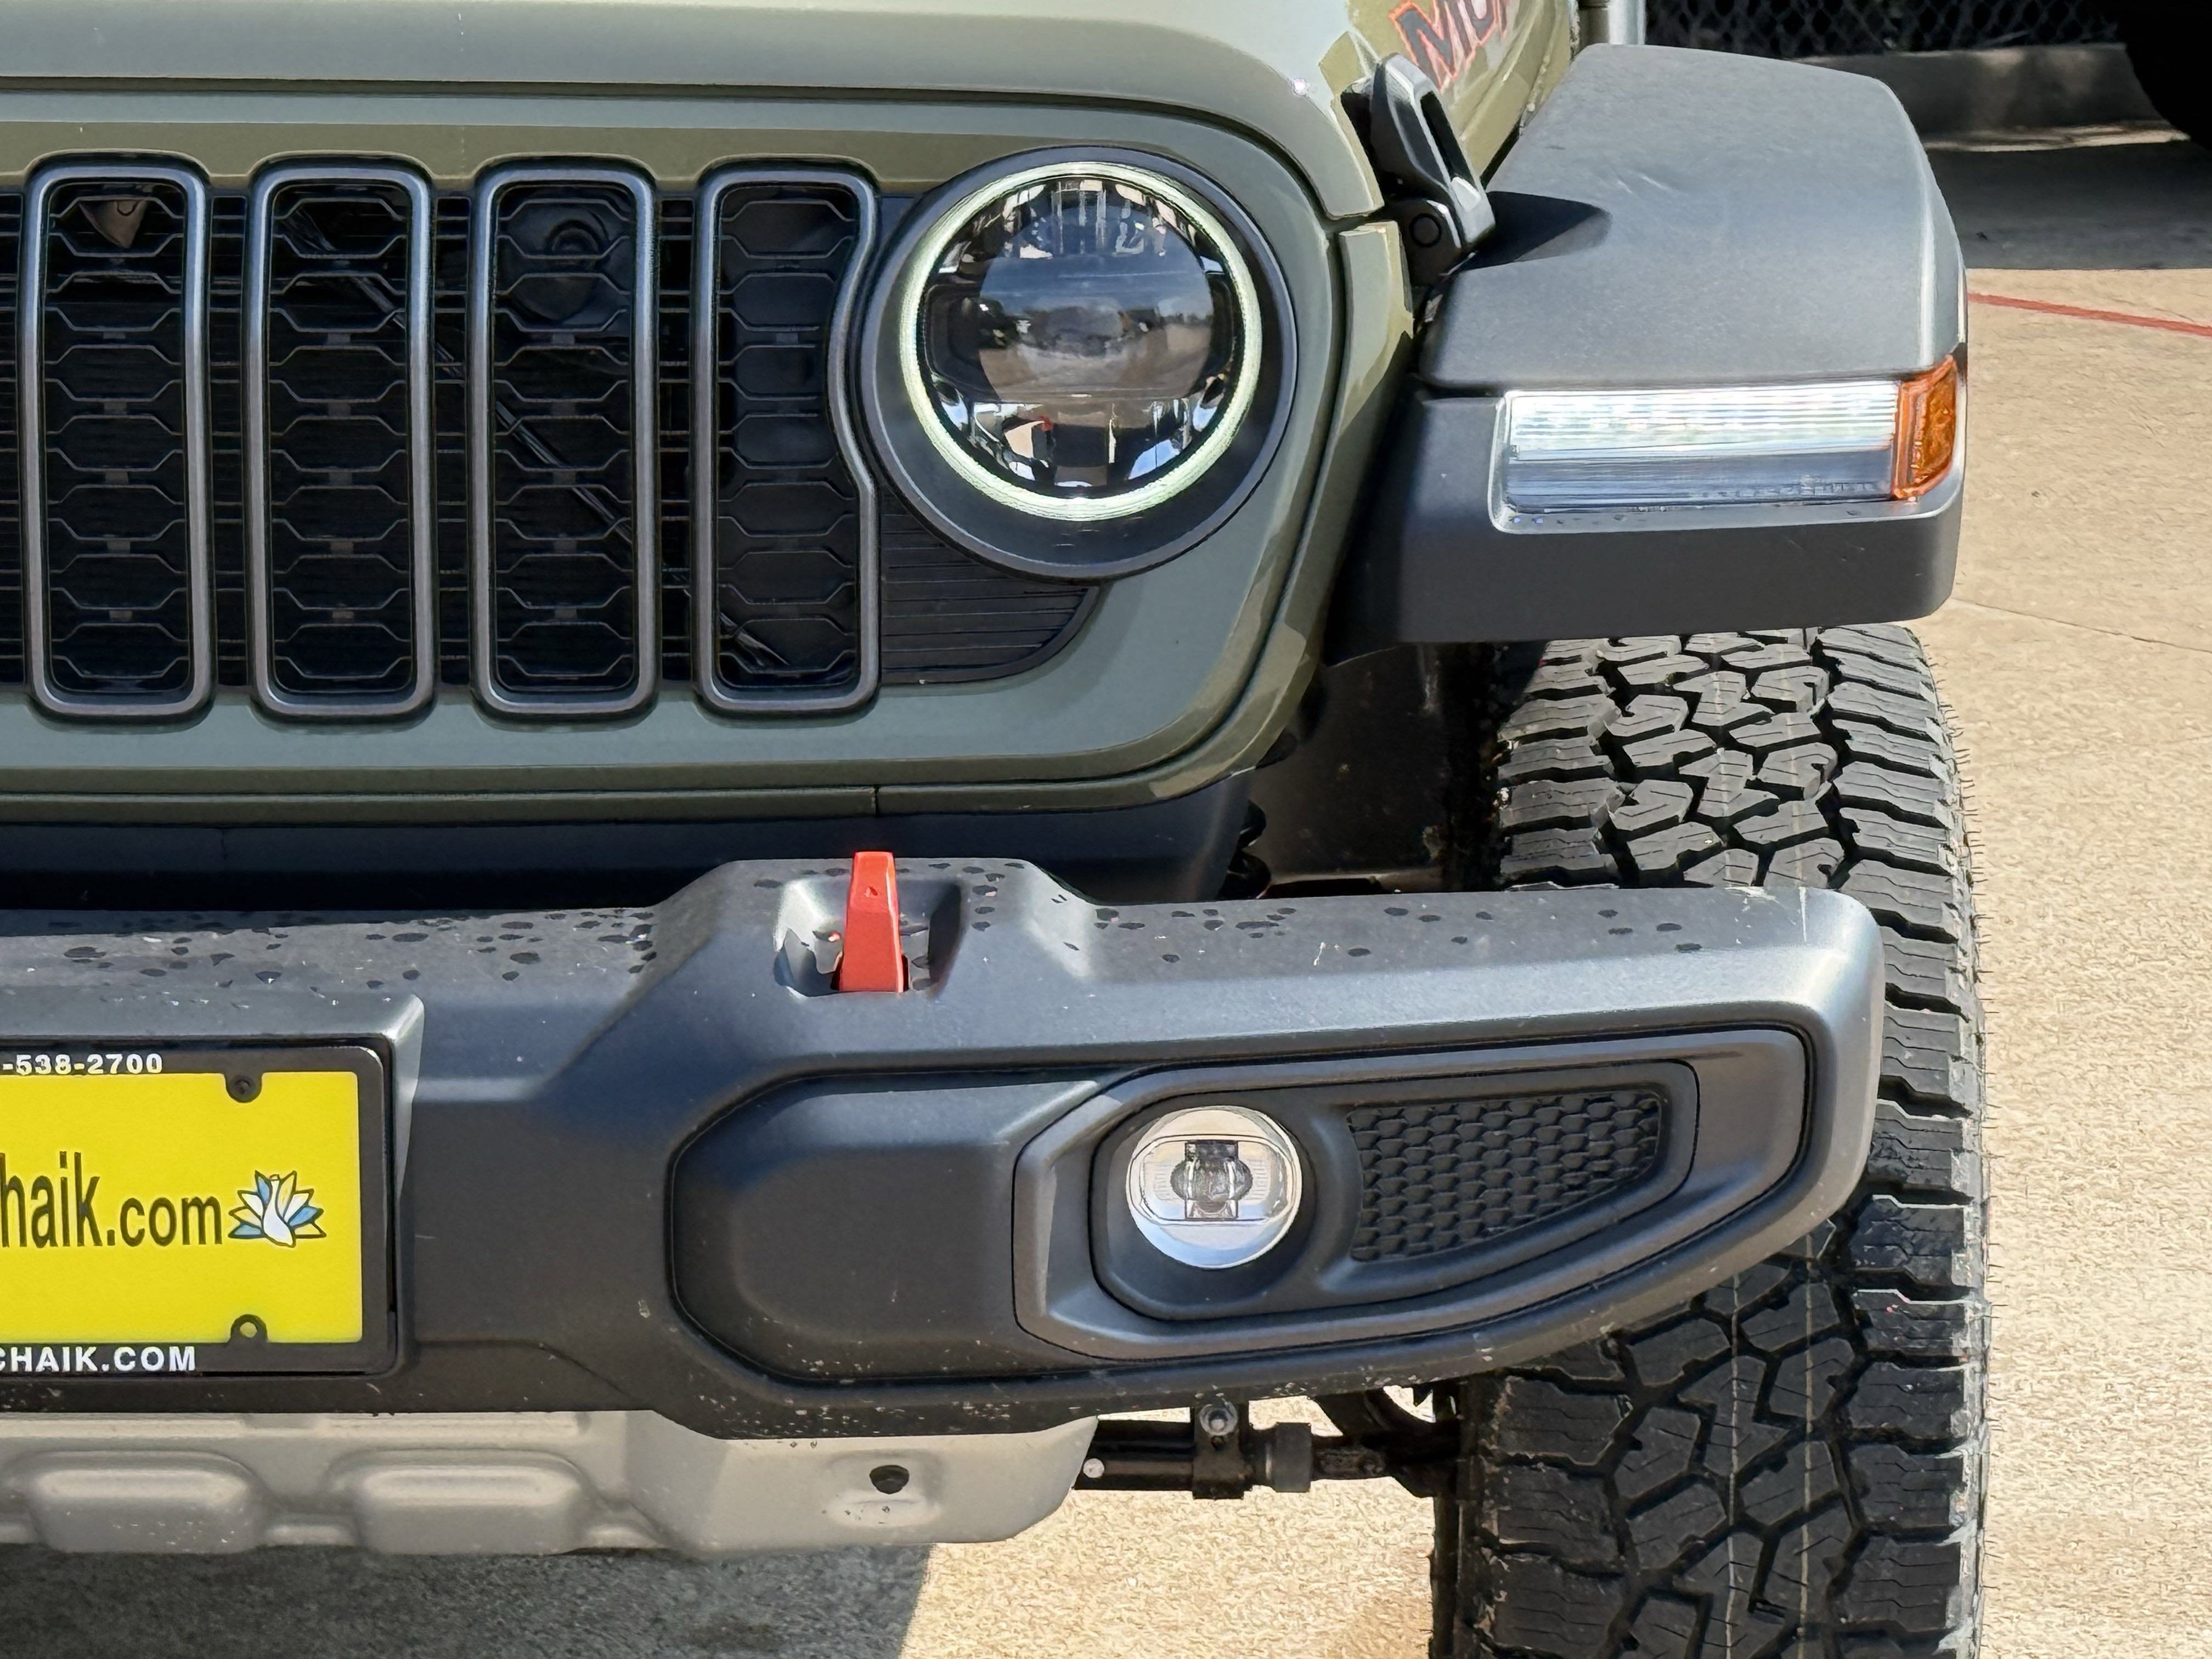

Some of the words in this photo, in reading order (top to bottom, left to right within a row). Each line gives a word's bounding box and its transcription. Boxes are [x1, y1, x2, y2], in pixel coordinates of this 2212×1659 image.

[2, 1053, 163, 1075] -538-2700
[0, 1150, 223, 1248] haik.com
[0, 1346, 196, 1372] HAIK.COM
